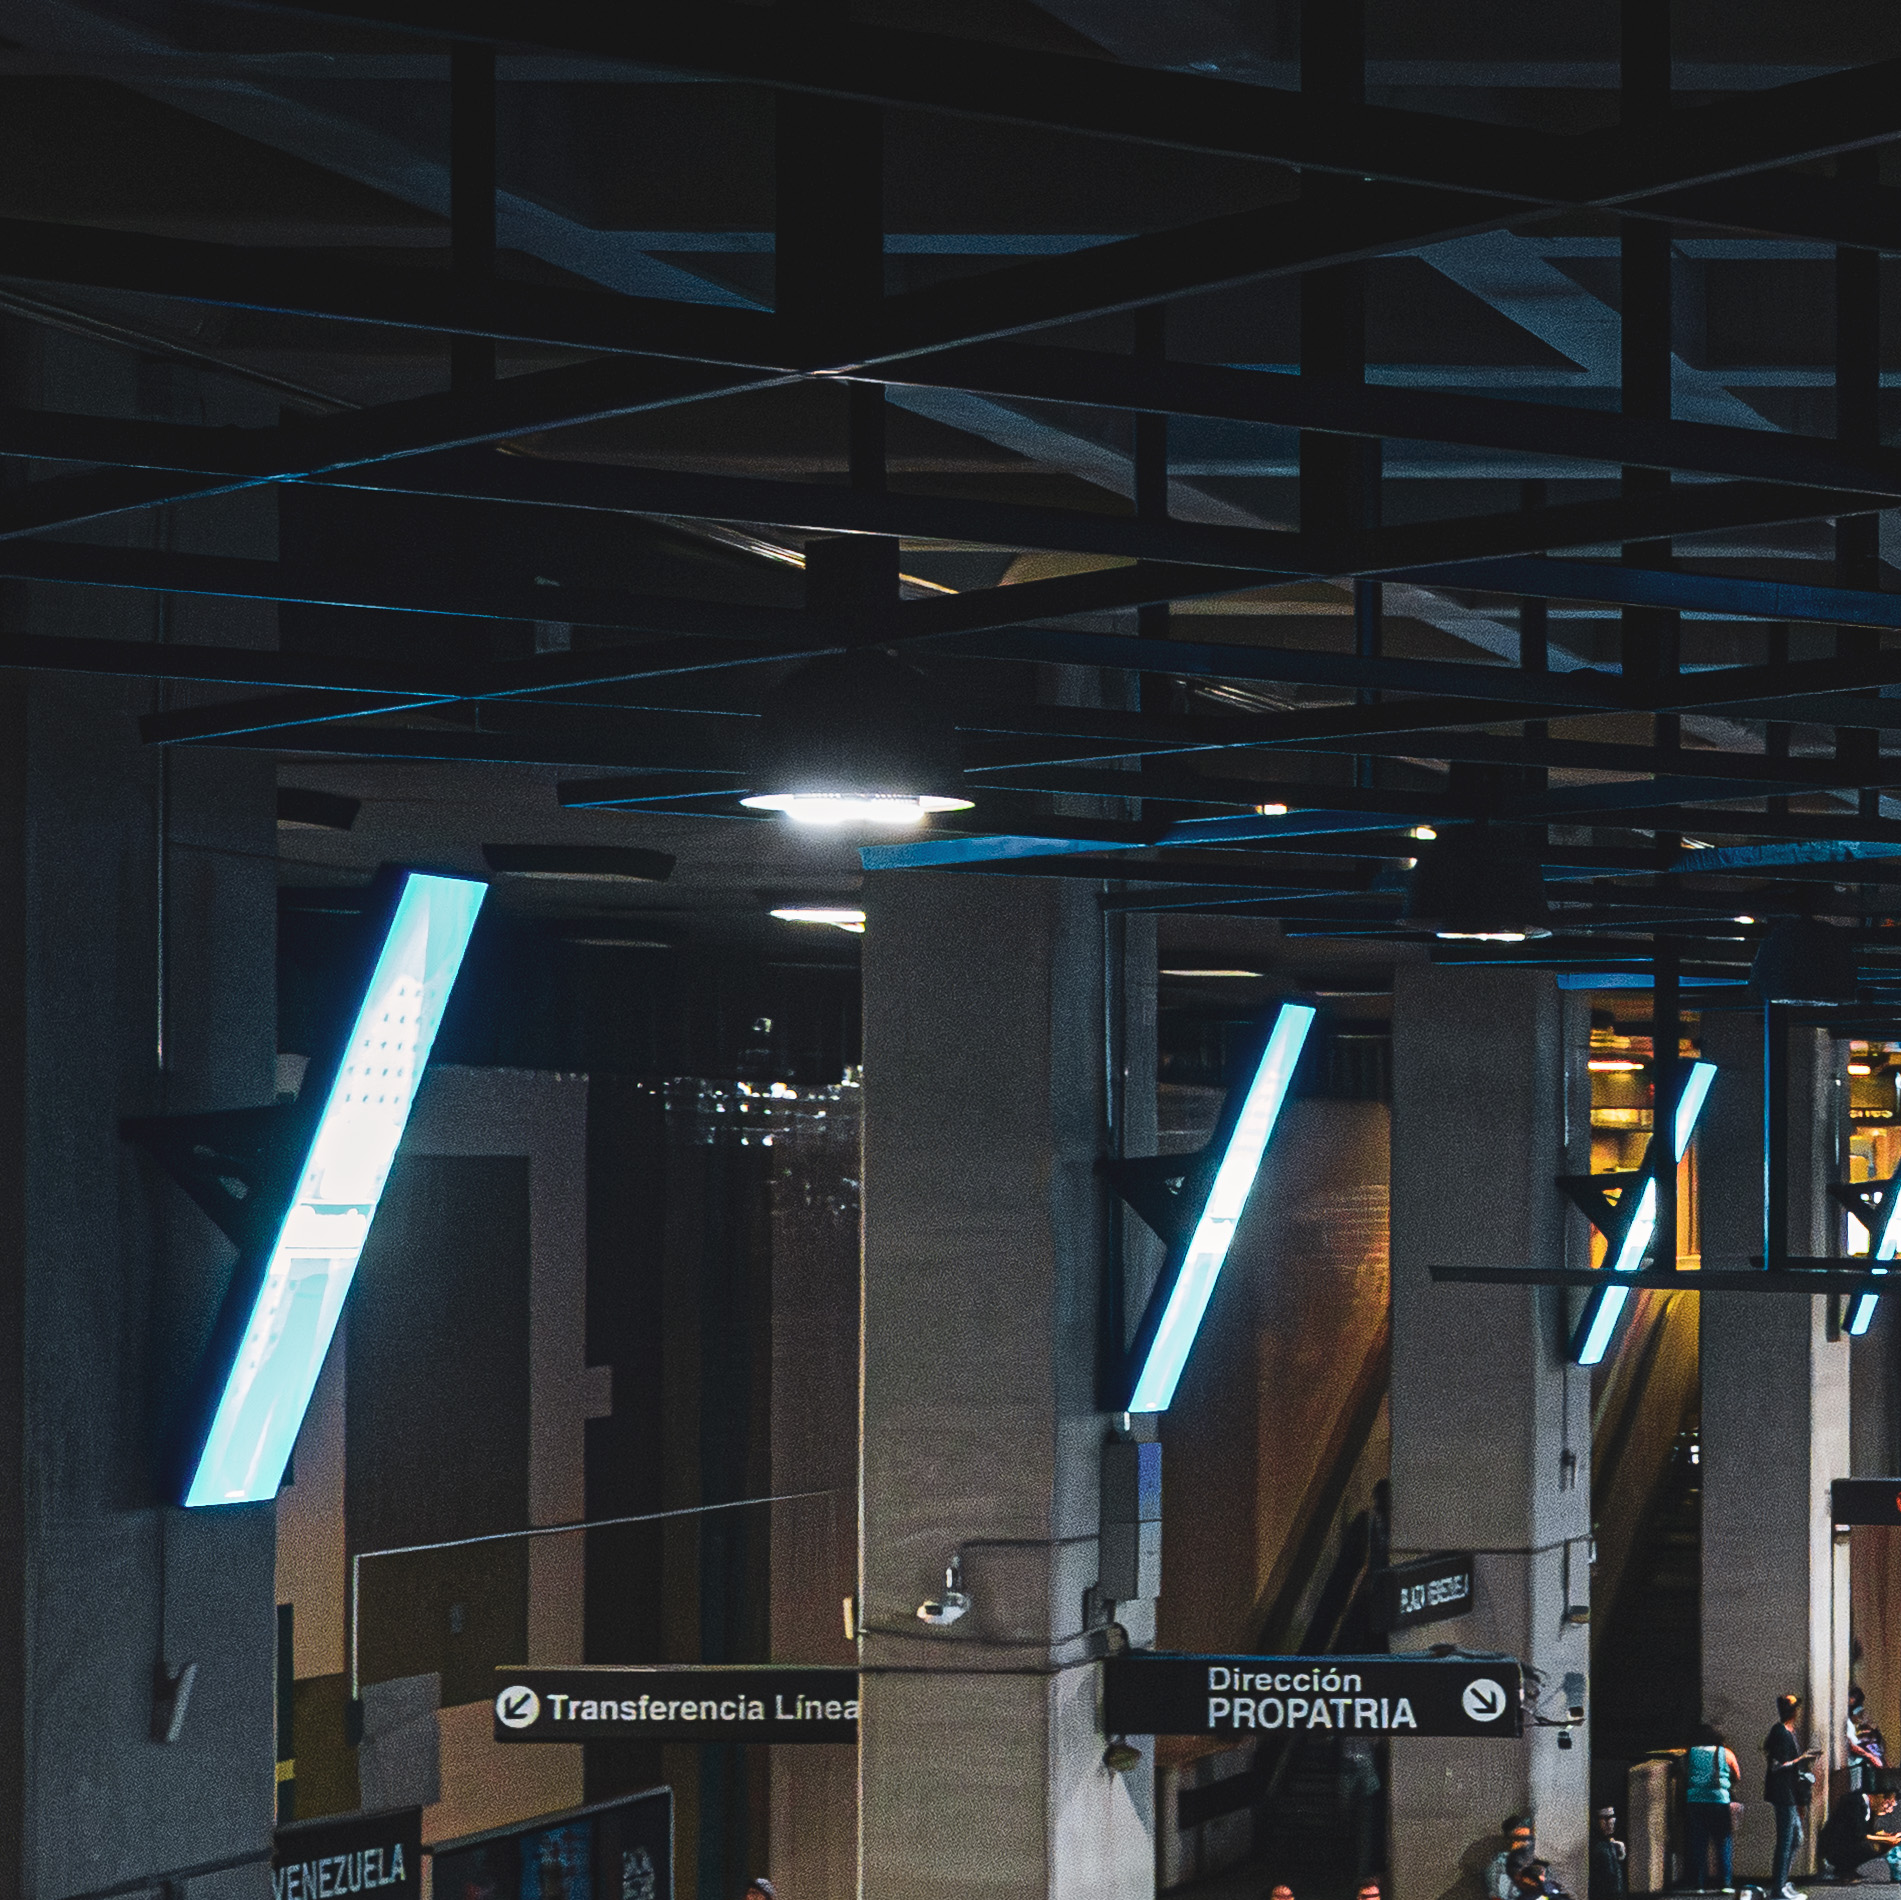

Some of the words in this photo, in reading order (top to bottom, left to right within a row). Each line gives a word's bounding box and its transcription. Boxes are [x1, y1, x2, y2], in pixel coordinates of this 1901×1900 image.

[1208, 1666, 1362, 1692] Dirección
[546, 1693, 764, 1722] Transferencia
[775, 1693, 860, 1721] Línea
[1207, 1697, 1418, 1729] PROPATRIA
